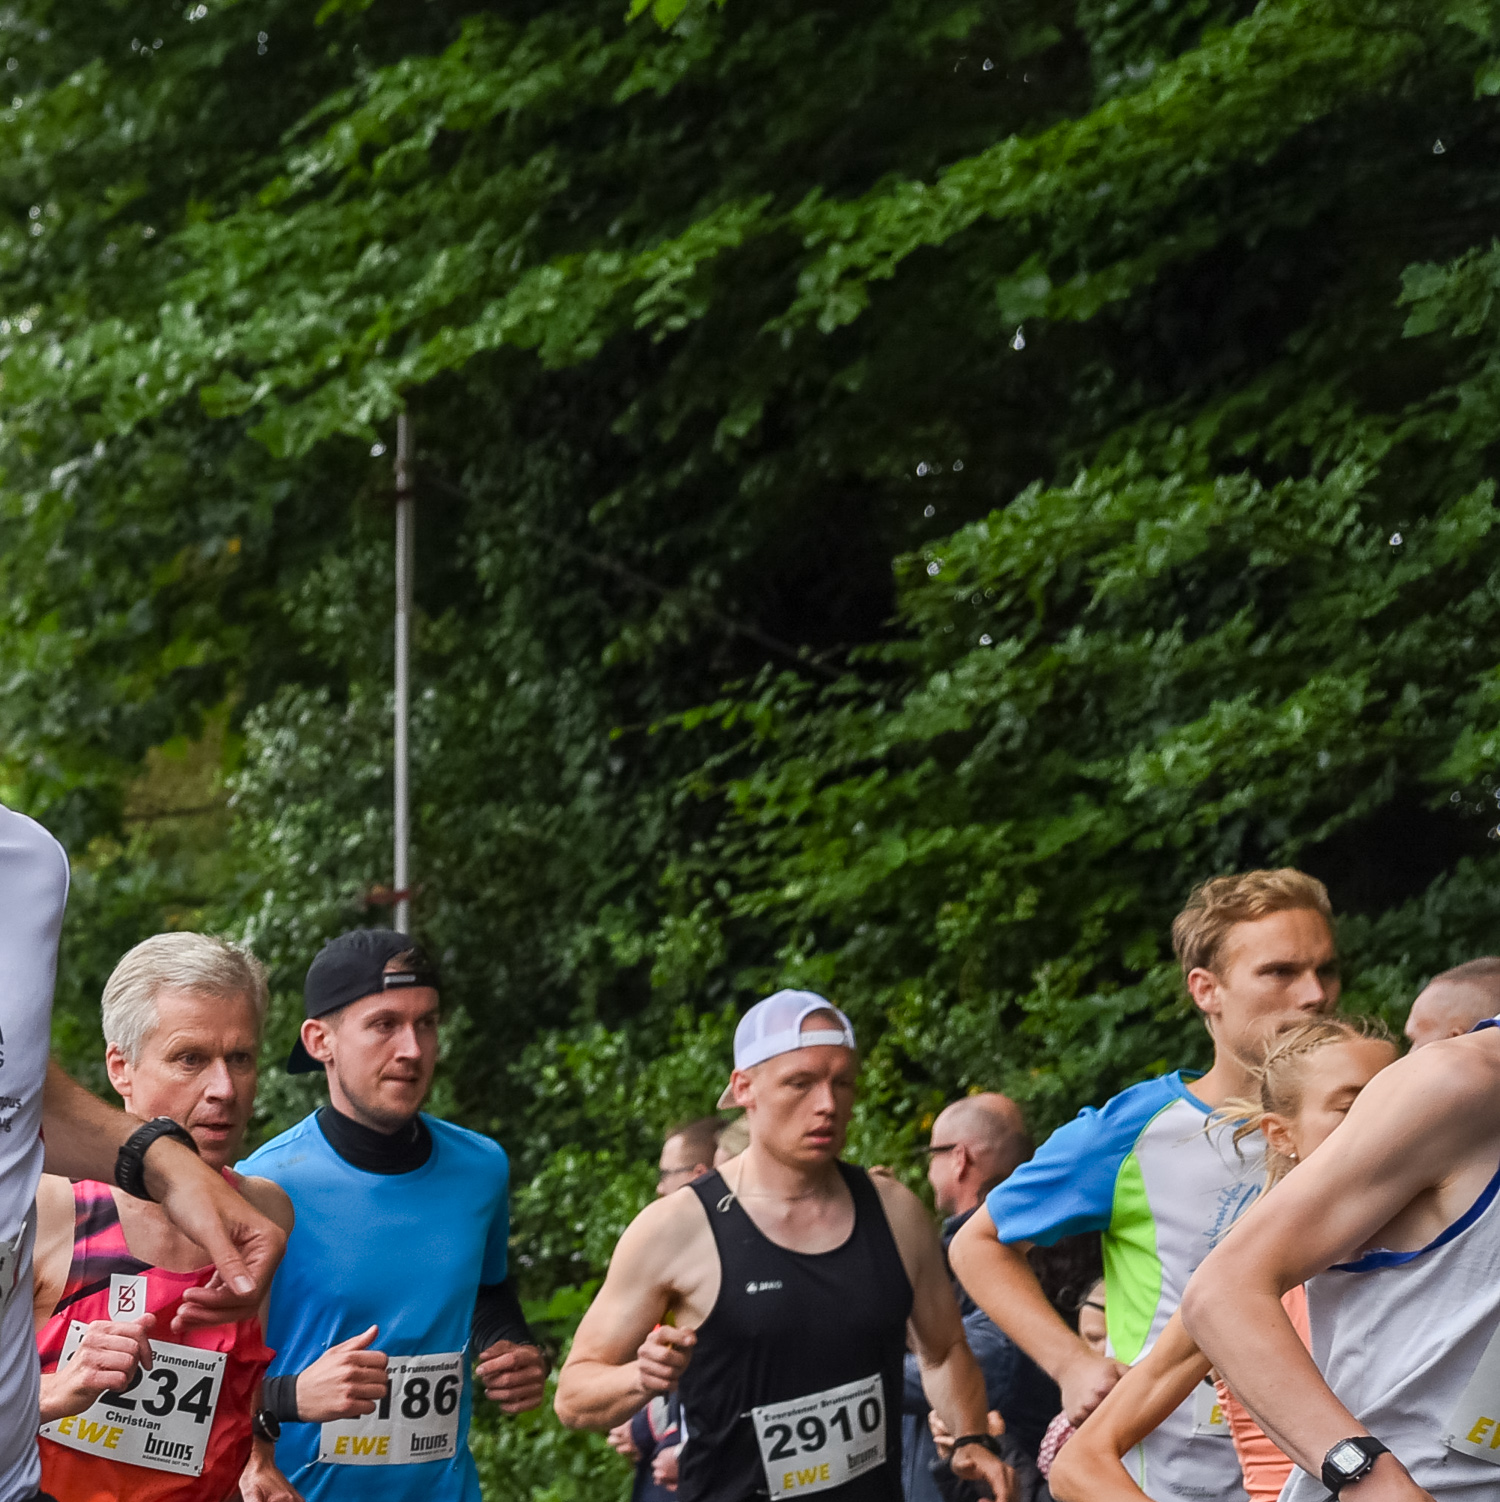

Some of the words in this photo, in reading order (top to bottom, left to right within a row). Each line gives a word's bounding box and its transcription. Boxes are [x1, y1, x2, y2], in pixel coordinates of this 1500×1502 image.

[400, 1360, 459, 1375] Brunnenlauf
[57, 1415, 125, 1450] EWE
[105, 1409, 162, 1431] Christian
[763, 1396, 881, 1463] 2910
[144, 1432, 194, 1461] bruns
[333, 1435, 391, 1456] EWE
[410, 1432, 449, 1452] bruns
[783, 1462, 831, 1490] EWE
